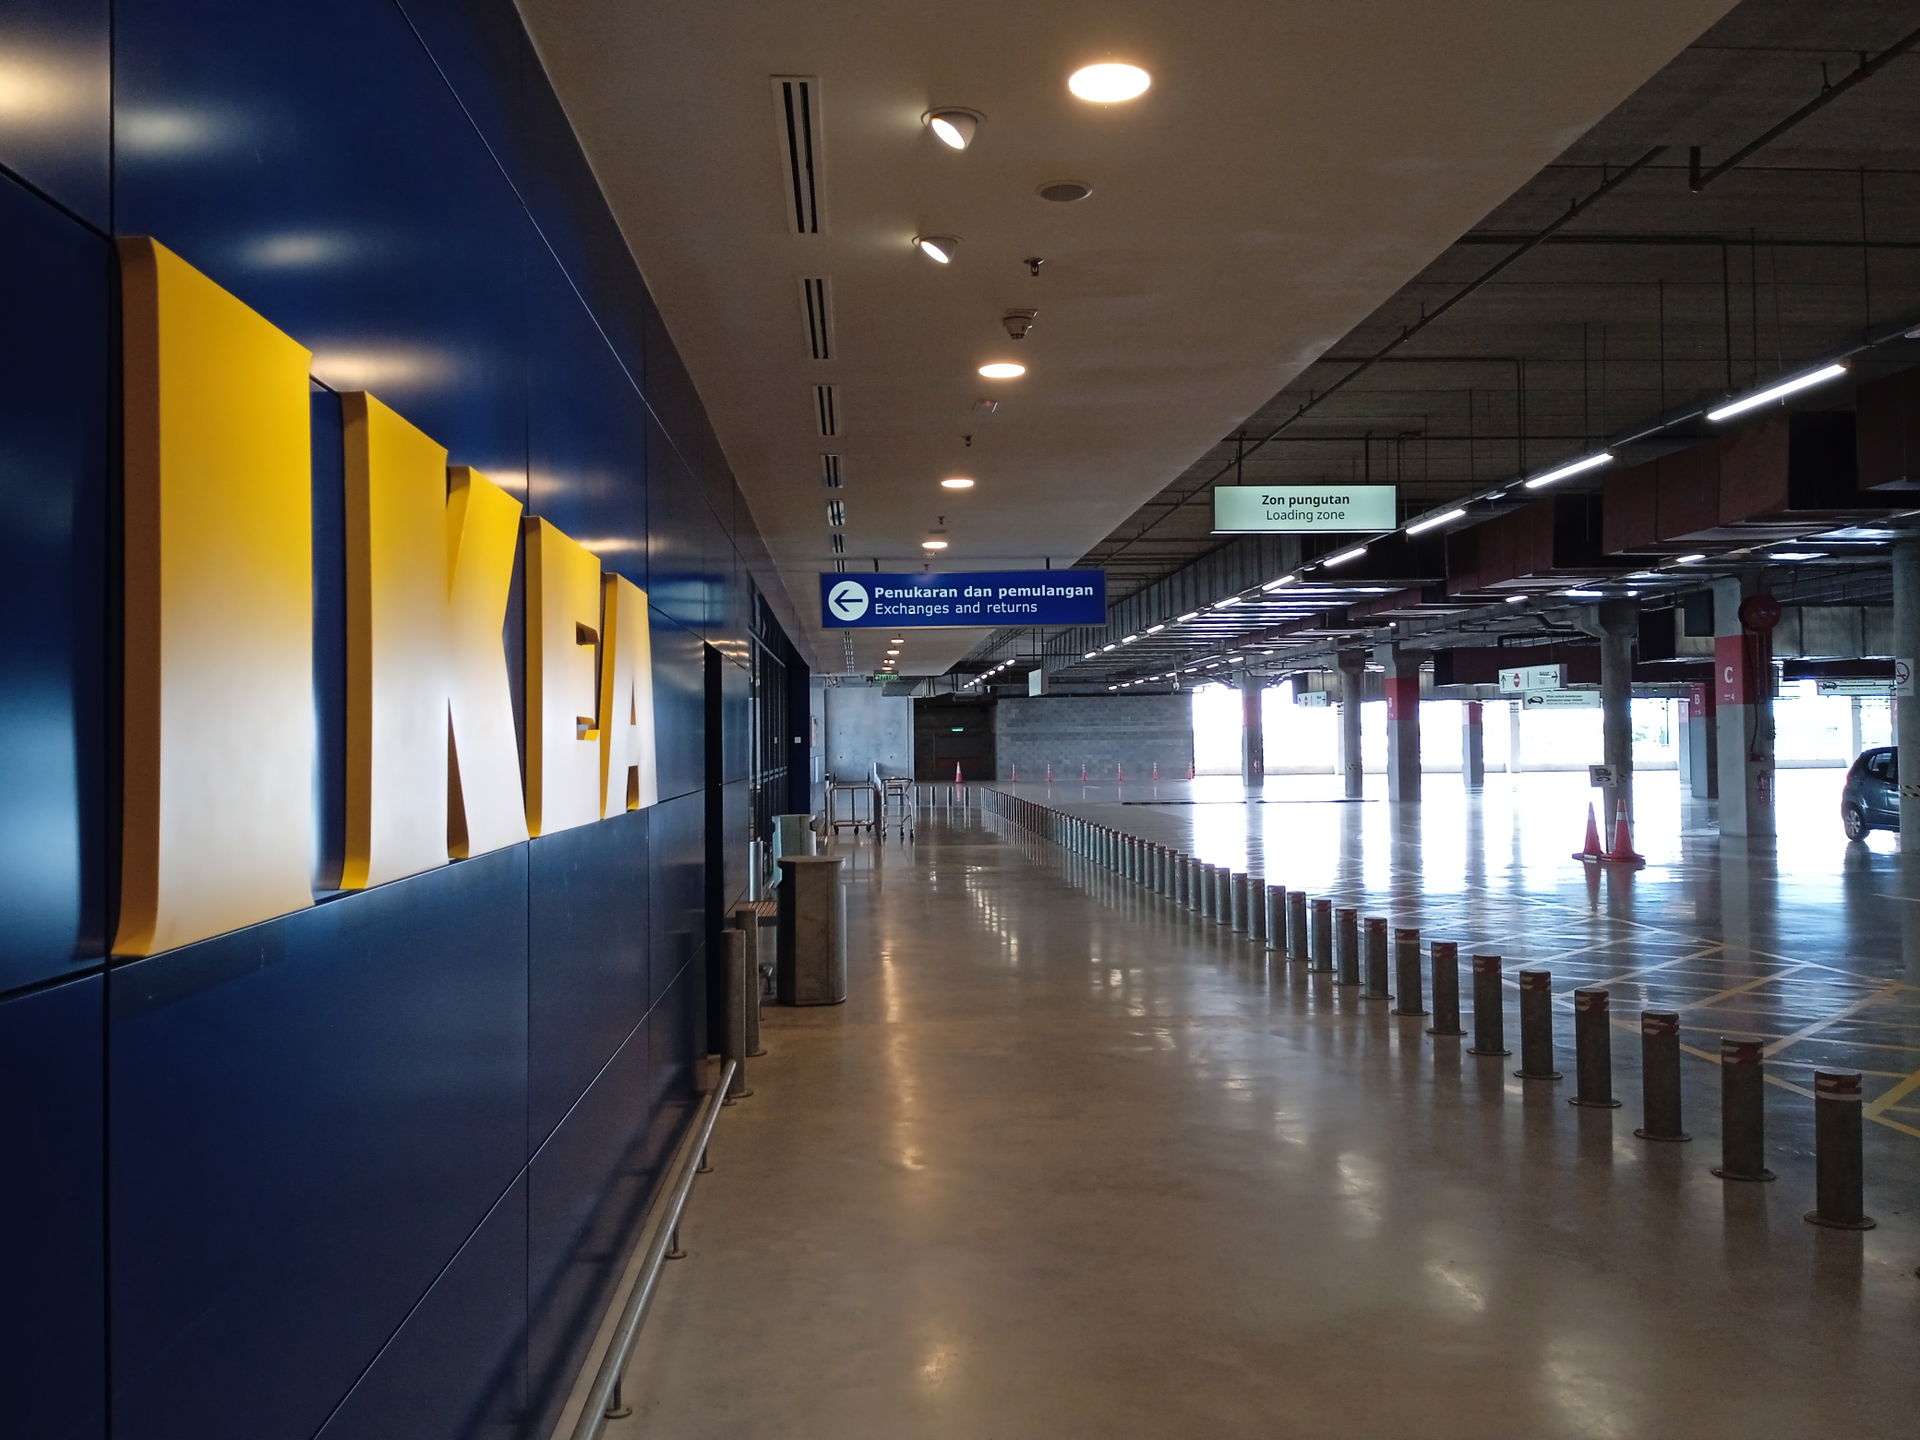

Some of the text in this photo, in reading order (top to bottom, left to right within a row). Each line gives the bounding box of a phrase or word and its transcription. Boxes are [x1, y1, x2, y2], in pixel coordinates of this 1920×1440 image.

[1262, 495, 1350, 508] Zon pungutan
[1266, 510, 1345, 523] Loading zone
[111, 236, 657, 957] IKEA
[875, 584, 1094, 600] Penukaran dan pemulangan
[875, 602, 1038, 616] Exchanges and returns
[1724, 666, 1734, 684] C
[1694, 694, 1701, 705] B
